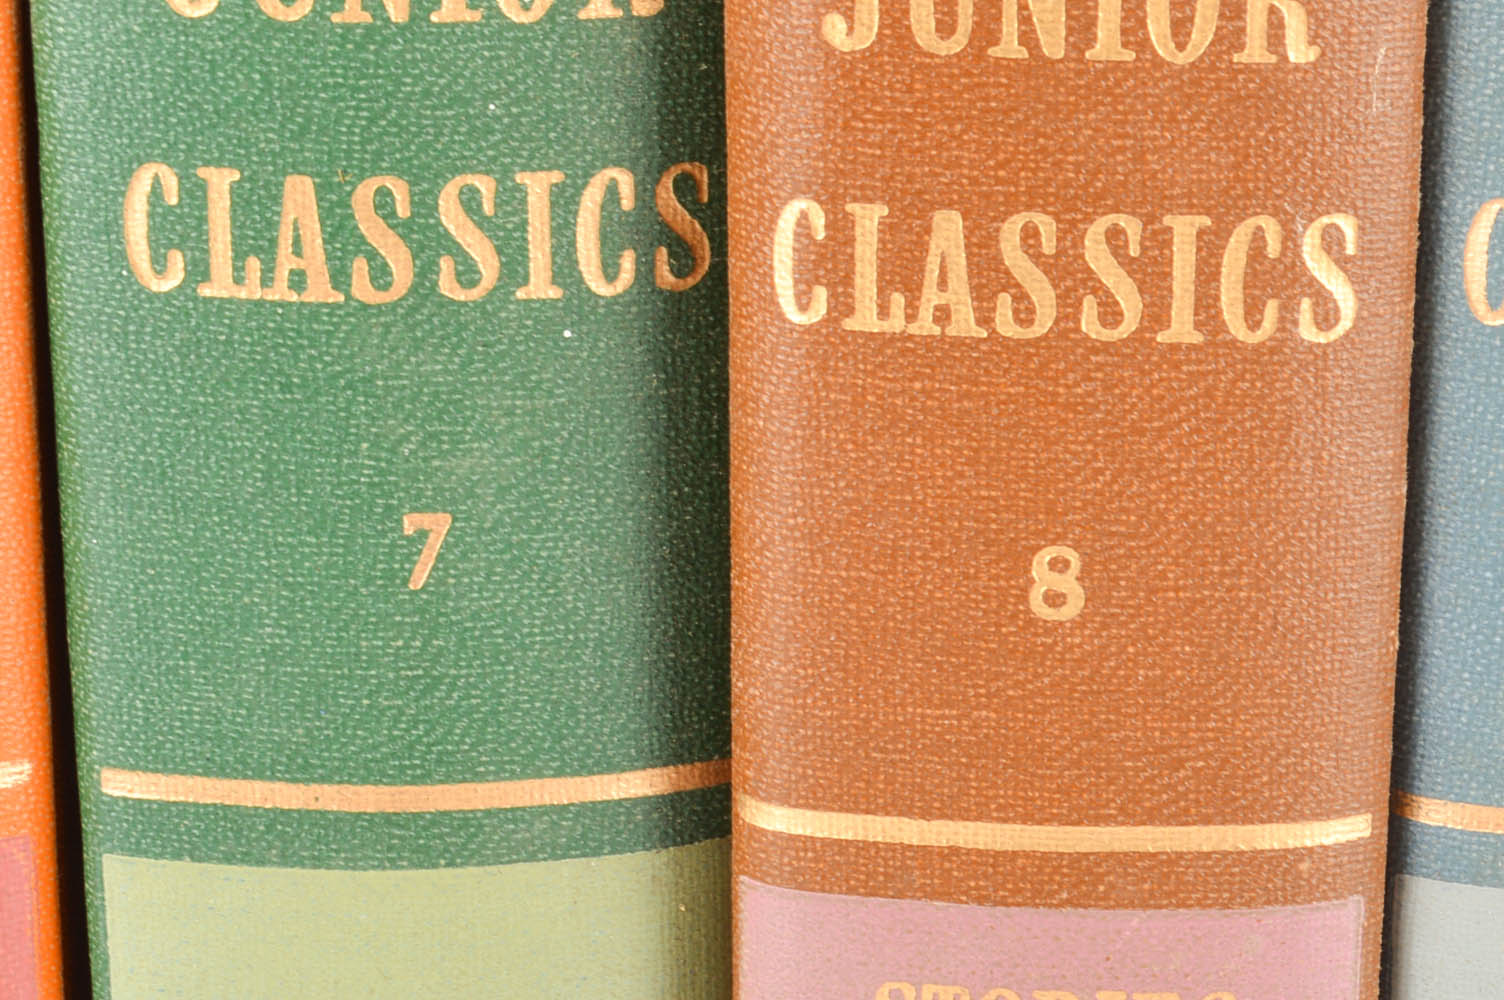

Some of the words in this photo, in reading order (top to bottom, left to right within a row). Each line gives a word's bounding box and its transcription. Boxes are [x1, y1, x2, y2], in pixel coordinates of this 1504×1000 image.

[122, 161, 712, 305] CLASSICS
[771, 197, 1361, 344] CLASSICS
[402, 512, 453, 591] 7
[1028, 545, 1087, 622] 8
